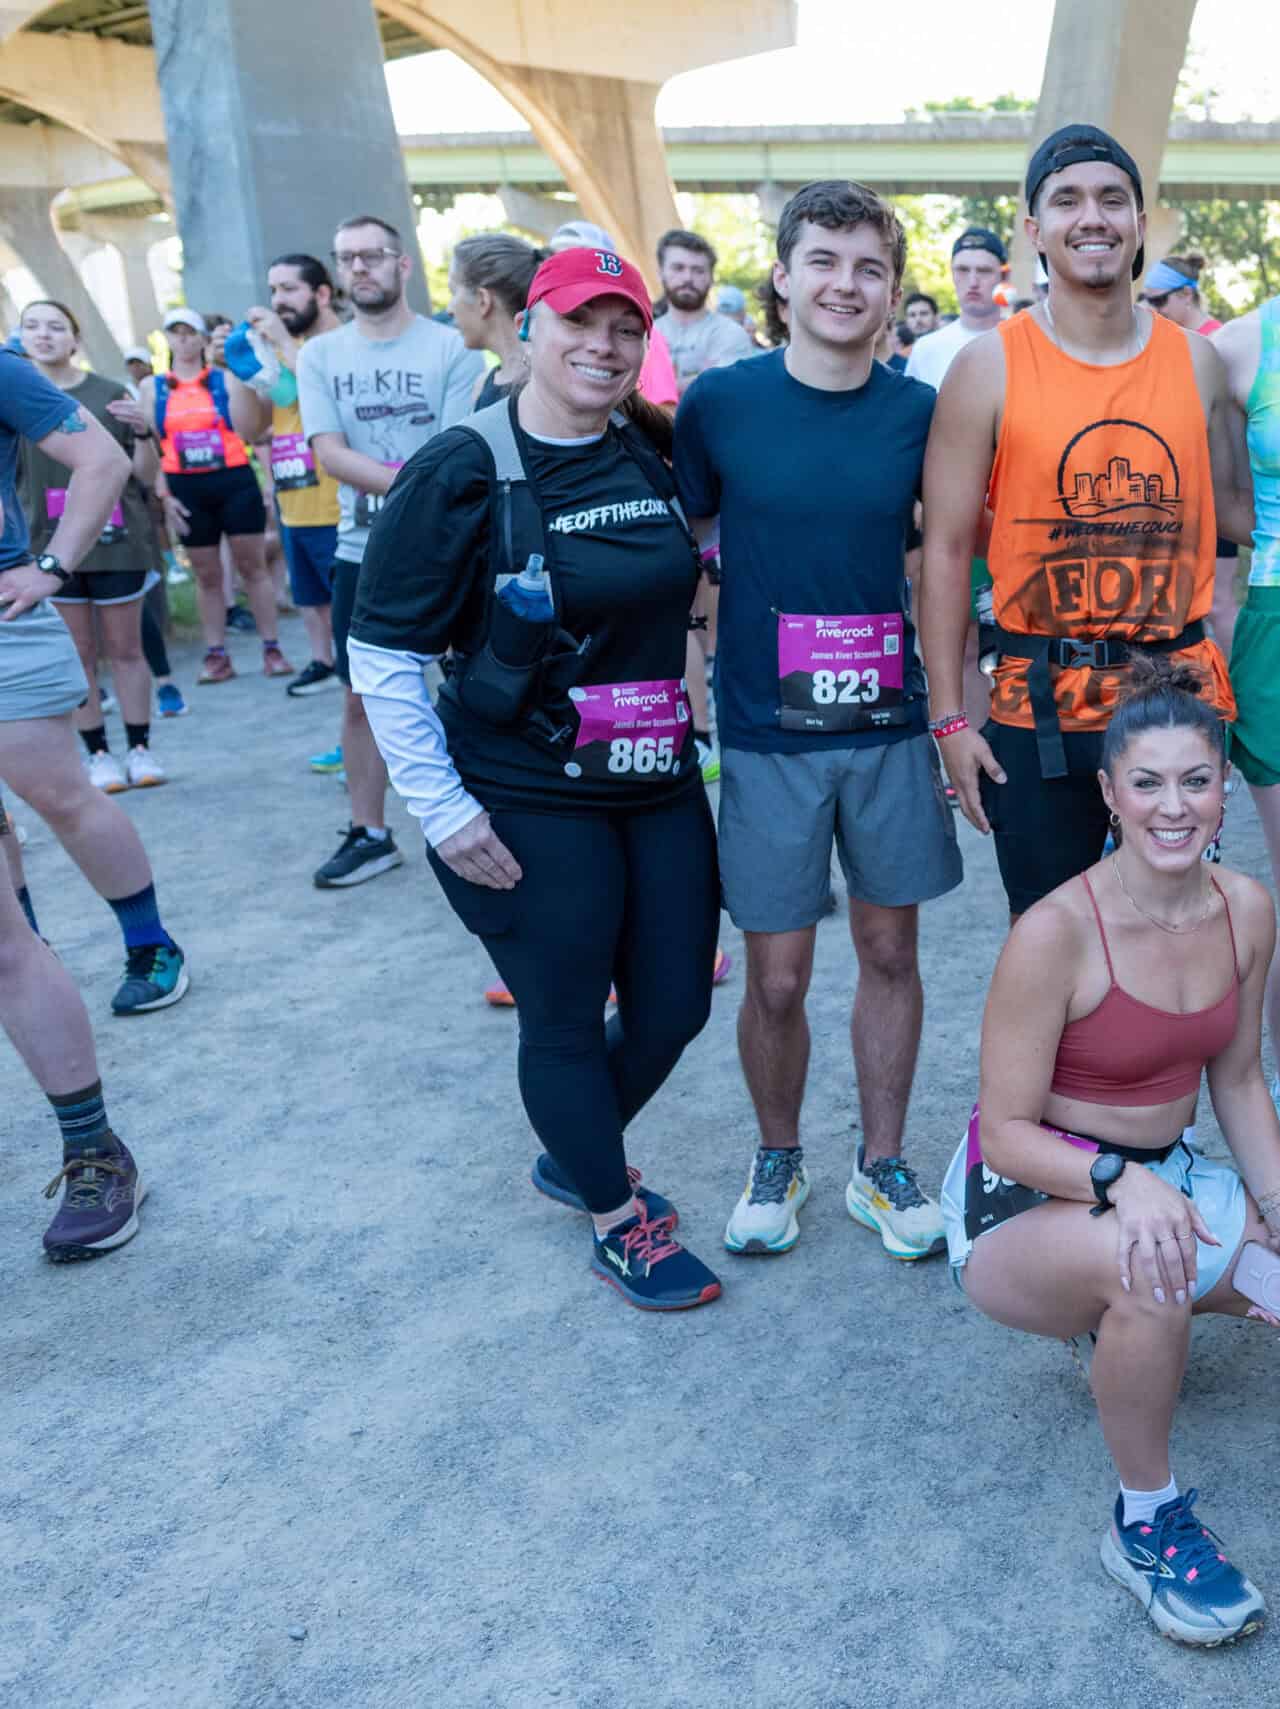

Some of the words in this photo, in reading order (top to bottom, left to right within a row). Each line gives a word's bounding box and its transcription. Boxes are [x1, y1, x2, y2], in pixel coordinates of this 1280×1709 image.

[594, 252, 624, 277] B
[333, 369, 425, 400] HKIE
[1050, 560, 1174, 614] FOR
[815, 624, 875, 639] riverrock
[614, 689, 670, 709] riverrock
[812, 668, 880, 704] 823
[607, 737, 674, 774] 865
